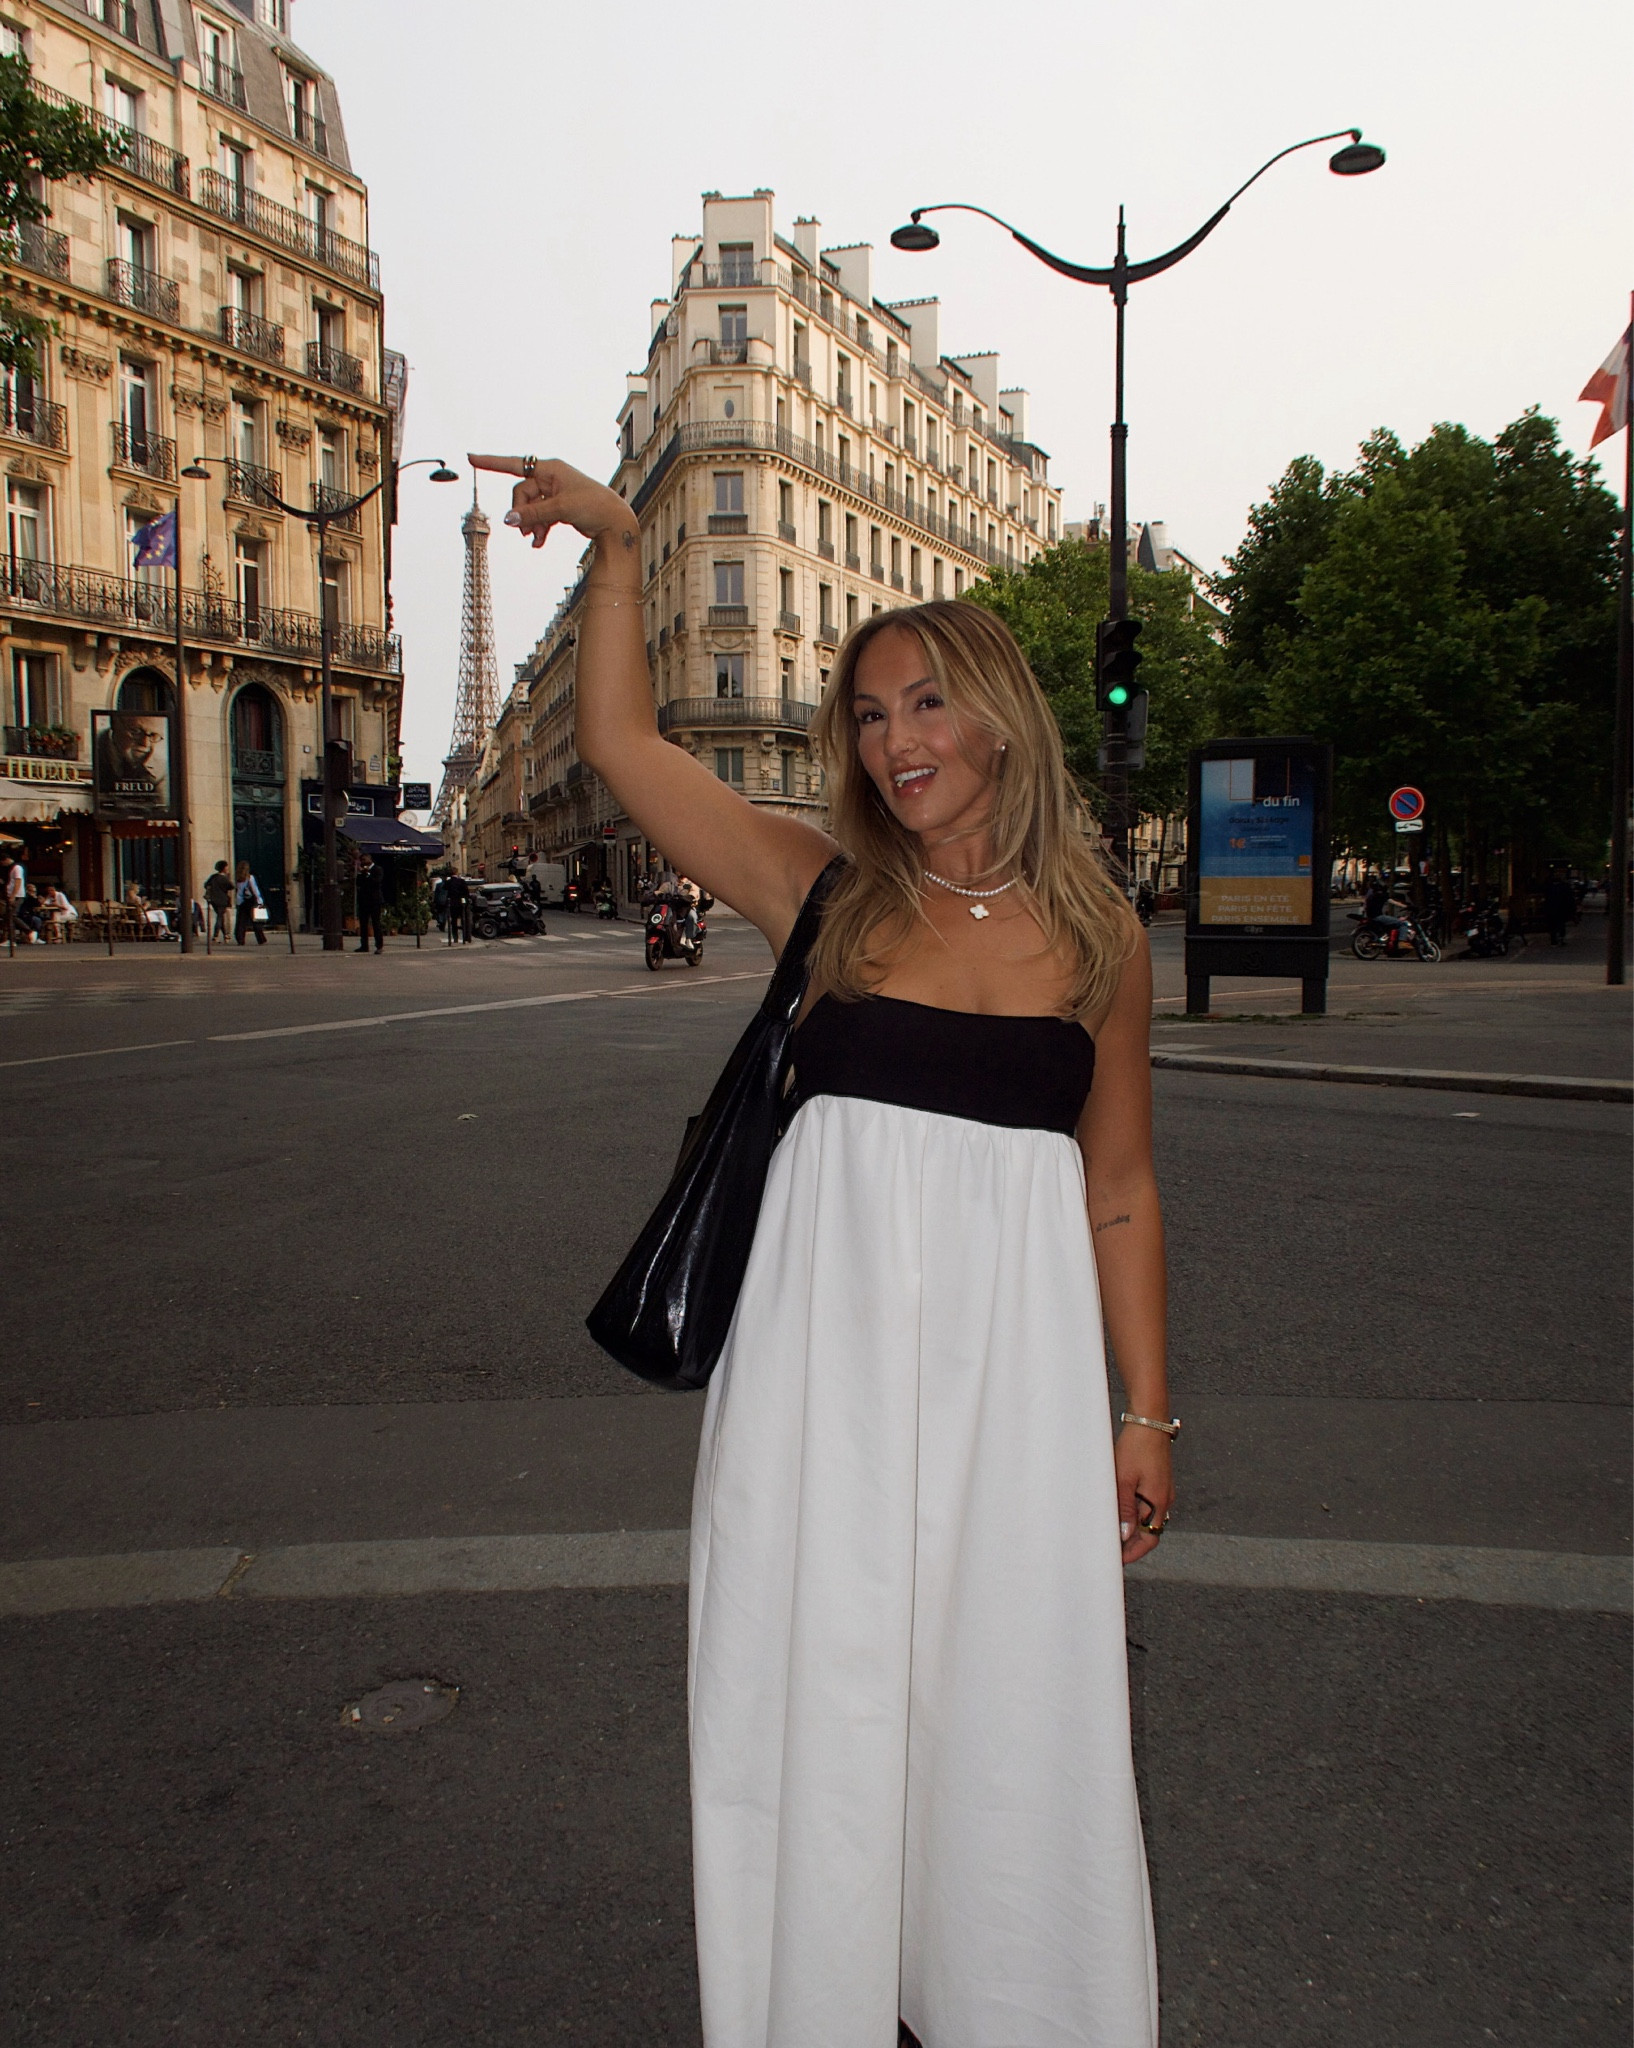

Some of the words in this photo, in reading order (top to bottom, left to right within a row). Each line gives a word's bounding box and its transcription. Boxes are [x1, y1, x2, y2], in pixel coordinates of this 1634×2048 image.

[114, 782, 155, 792] FREUD
[1263, 795, 1280, 807] du
[1283, 795, 1300, 807] fin
[1211, 915, 1241, 923] PARIS
[1244, 915, 1300, 923] ENSEMBLE
